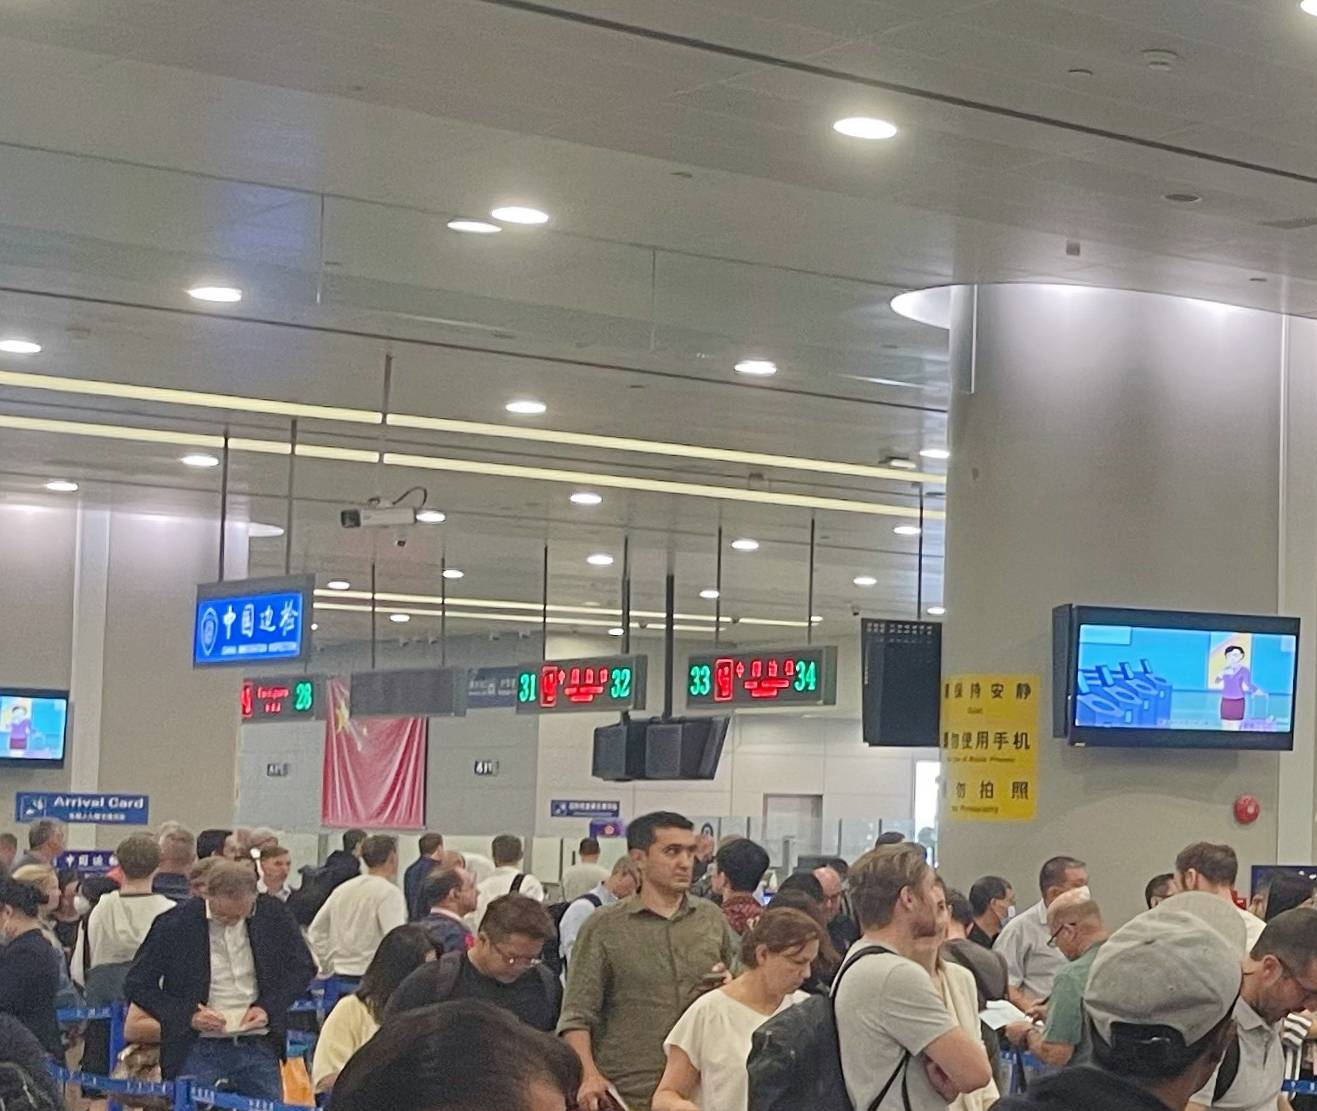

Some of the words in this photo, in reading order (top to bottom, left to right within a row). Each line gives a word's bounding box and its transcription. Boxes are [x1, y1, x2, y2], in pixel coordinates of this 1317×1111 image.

[222, 599, 299, 640] 中国边检
[518, 672, 537, 702] 31
[611, 667, 632, 698] 32
[690, 665, 712, 696] 33
[795, 660, 816, 691] 34
[54, 795, 105, 808] Arrival
[108, 797, 144, 809] Card
[944, 780, 1029, 800] 勿拍照
